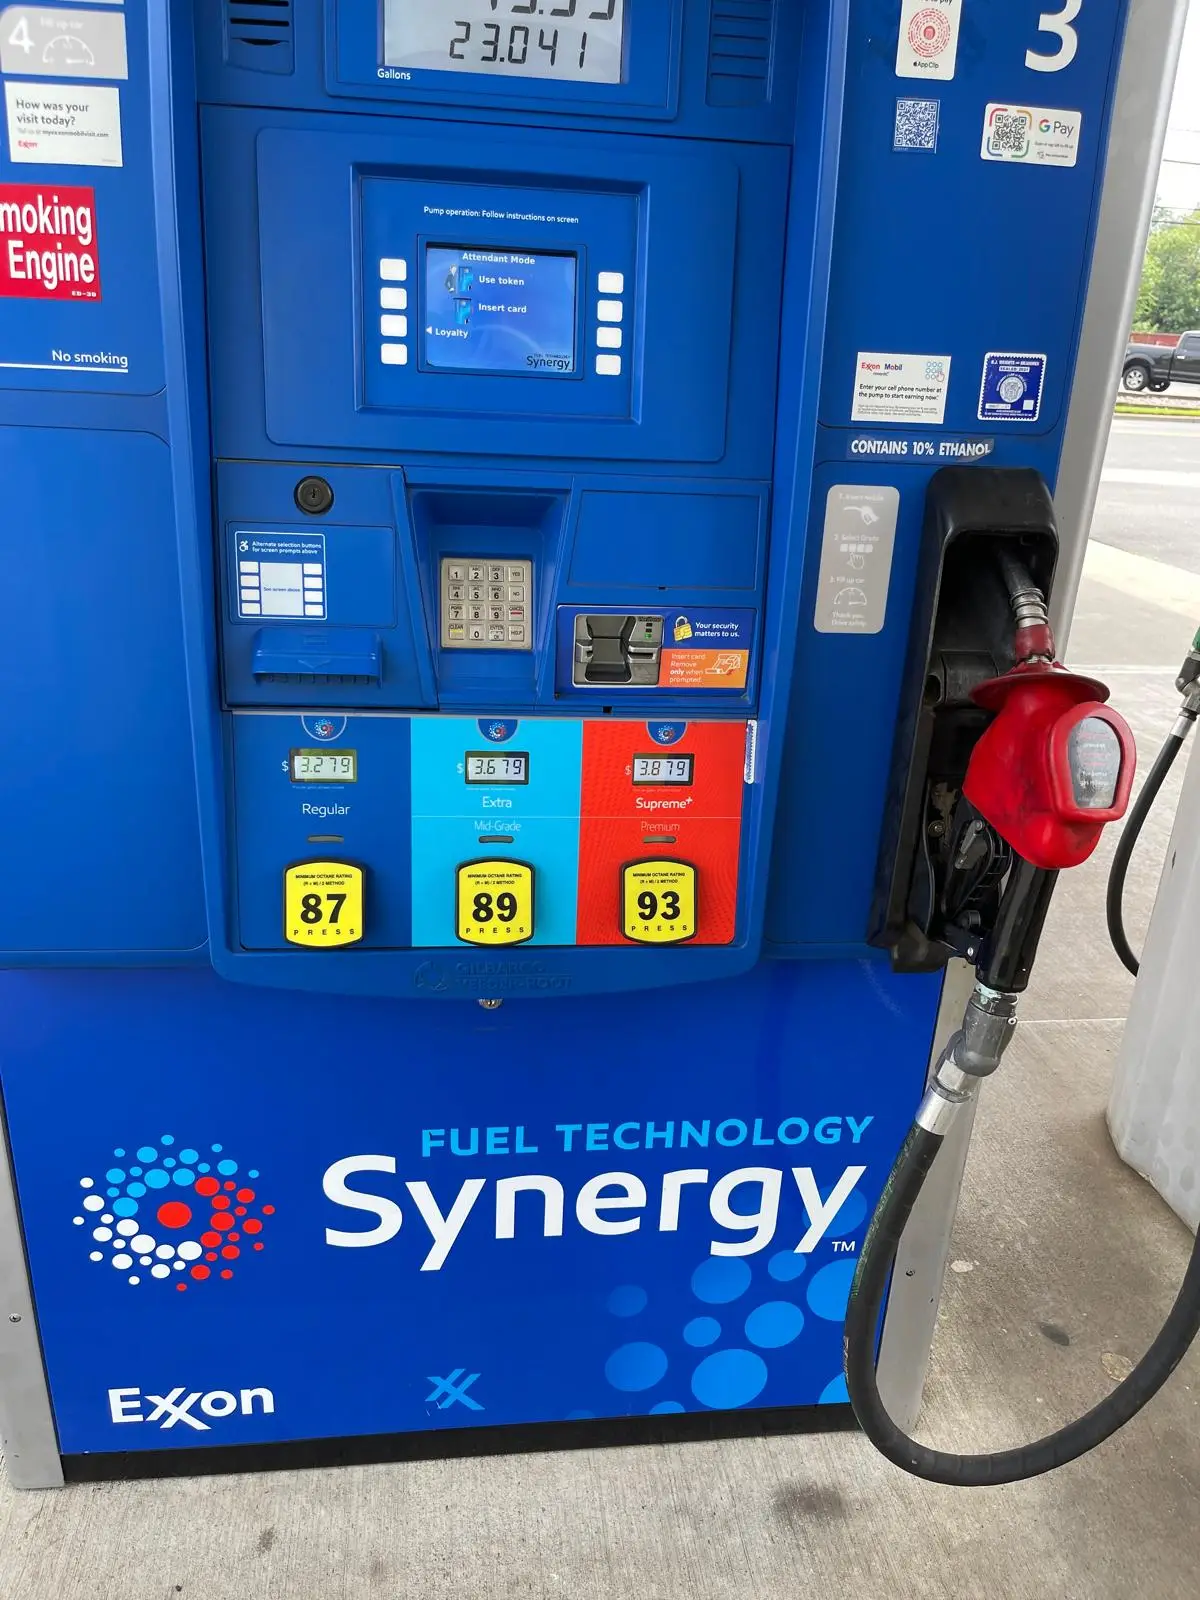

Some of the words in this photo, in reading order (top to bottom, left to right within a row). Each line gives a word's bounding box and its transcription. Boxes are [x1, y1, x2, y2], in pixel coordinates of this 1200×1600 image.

[8, 16, 35, 54] 4
[1025, 0, 1082, 72] 3
[450, 20, 587, 69] 23.041
[377, 68, 411, 80] Gallons
[16, 99, 39, 109] How
[43, 102, 63, 111] was
[65, 103, 89, 114] your
[17, 113, 38, 124] visit
[41, 115, 76, 128] today?
[1053, 121, 1074, 138] Pay
[423, 206, 444, 216] Pump
[446, 208, 480, 218] operation:
[482, 210, 504, 219] Follow
[506, 212, 545, 222] instructions
[556, 216, 579, 224] screen
[8, 240, 95, 290] Engine
[462, 253, 507, 263] Attendant
[510, 255, 535, 265] Mode
[479, 275, 495, 284] Use
[498, 276, 524, 286] token
[478, 303, 504, 312] Insert
[507, 304, 527, 313] card
[435, 328, 468, 339] Loyalty
[52, 349, 71, 362] No
[74, 351, 128, 368] smoking
[526, 355, 570, 370] Synergy
[861, 362, 880, 371] Exxon
[884, 363, 902, 371] Mobil
[851, 439, 908, 455] CONTAINS
[912, 441, 935, 456] 10%
[939, 442, 990, 456] ETHANOL
[713, 622, 739, 631] security
[670, 668, 685, 676] only
[281, 760, 289, 772] $
[301, 757, 351, 773] 3.279
[474, 759, 522, 774] 3.679
[625, 765, 632, 775] $
[640, 761, 686, 776] 3.879
[482, 796, 512, 808] Extra
[635, 796, 693, 811] Supreme+
[302, 803, 350, 818] Regular
[474, 820, 521, 831] Mid-Grade
[641, 821, 680, 831] Premium
[300, 893, 347, 924] 87
[472, 892, 517, 922] 89
[637, 891, 681, 920] 93
[421, 1124, 538, 1158] FUEL
[555, 1114, 875, 1153] TECHNOLOGY
[321, 1153, 868, 1272] Synergy
[108, 1386, 276, 1430] Exxon
